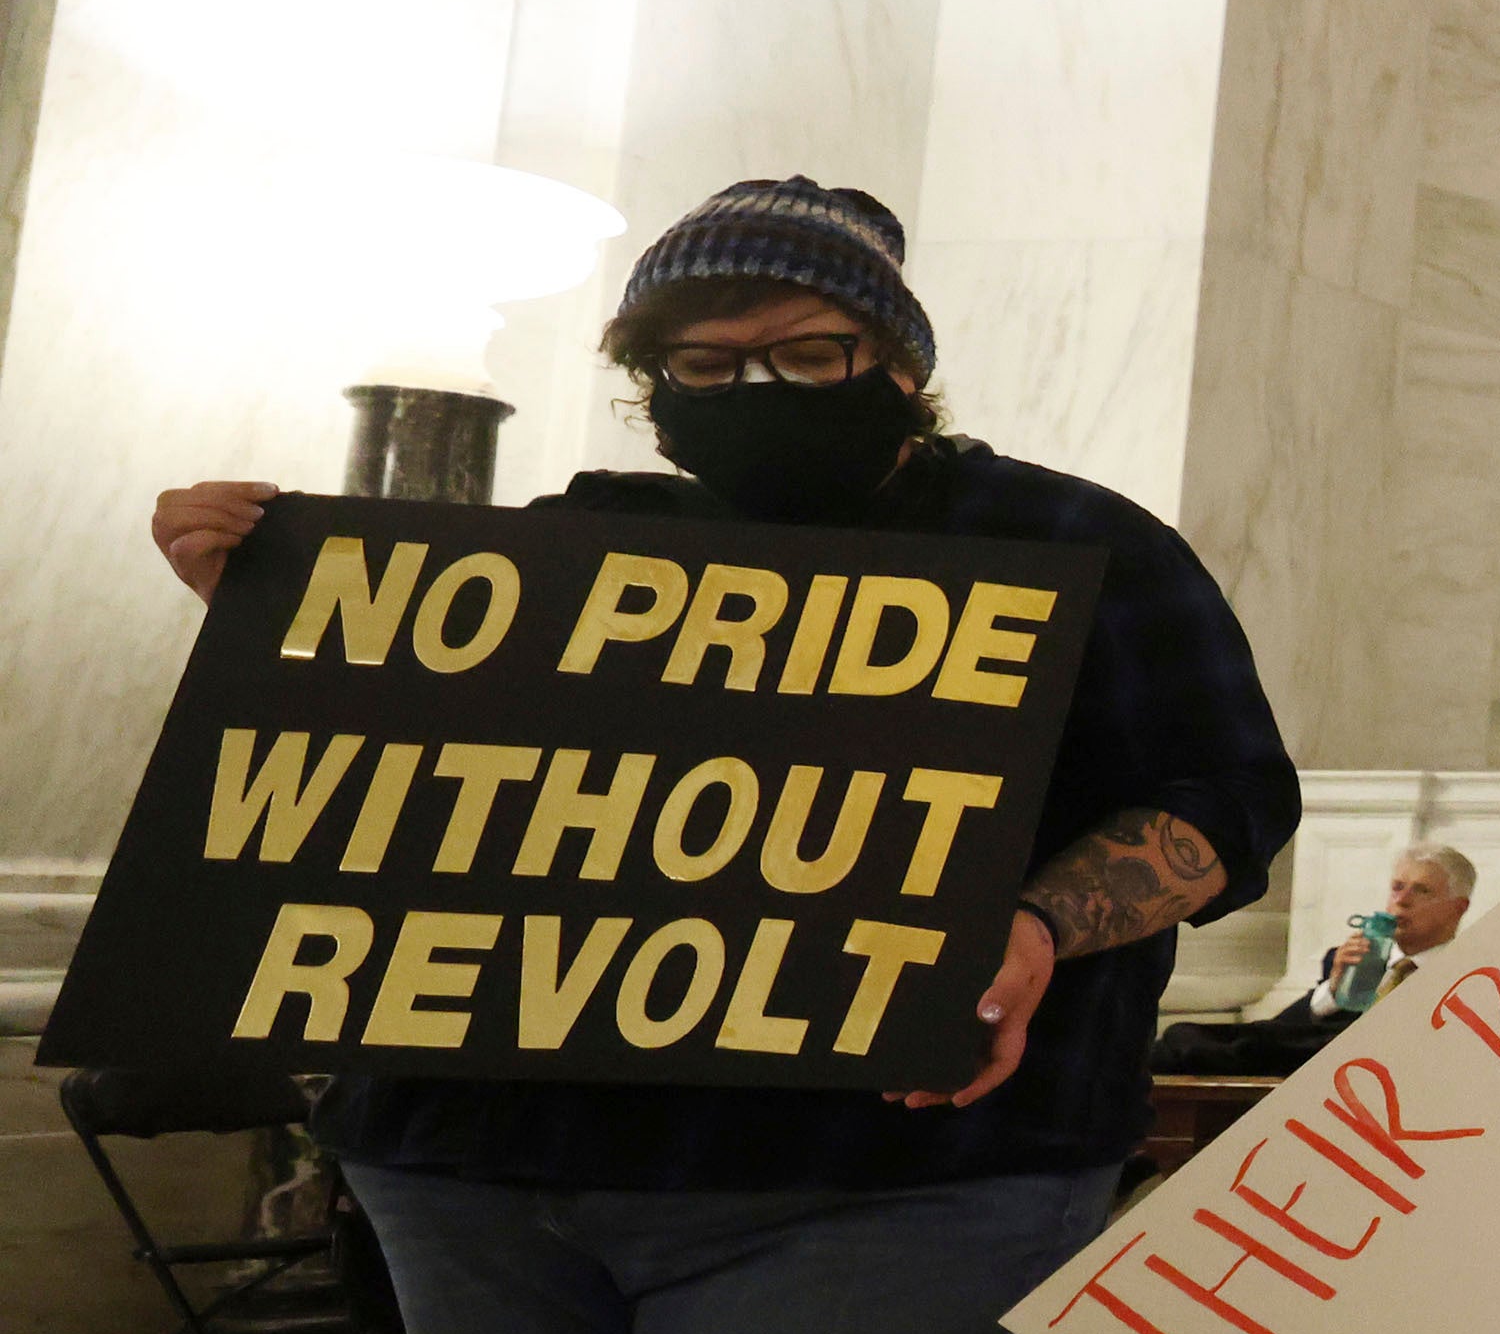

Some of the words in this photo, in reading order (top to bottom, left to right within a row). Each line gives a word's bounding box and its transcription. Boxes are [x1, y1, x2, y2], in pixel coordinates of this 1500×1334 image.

[280, 534, 521, 673] NO
[557, 551, 1058, 709] PRIDE
[204, 727, 1004, 897] WITHOUT
[231, 902, 946, 1056] REVOLT
